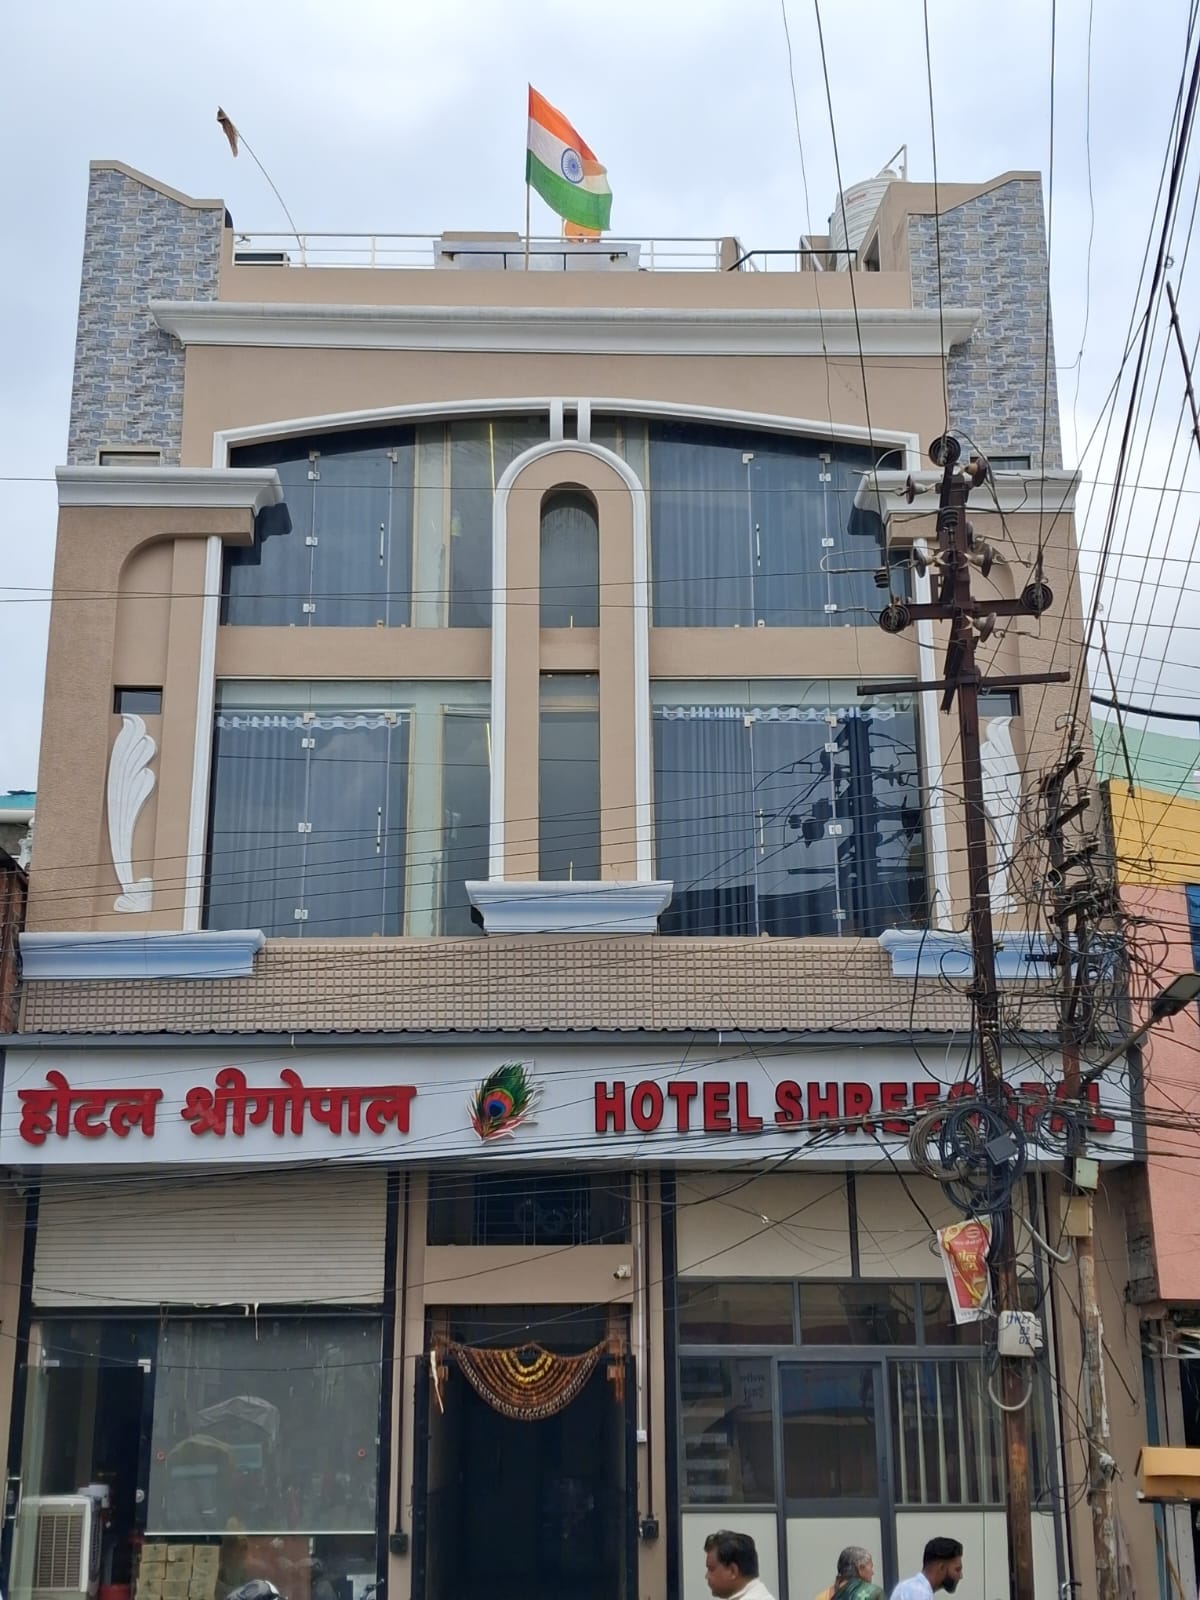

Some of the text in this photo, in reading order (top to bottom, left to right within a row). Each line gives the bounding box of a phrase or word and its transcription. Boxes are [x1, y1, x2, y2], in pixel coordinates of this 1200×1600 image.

[18, 1067, 418, 1146] होटल श्रीगोपाल
[594, 1080, 764, 1133] HOTEL
